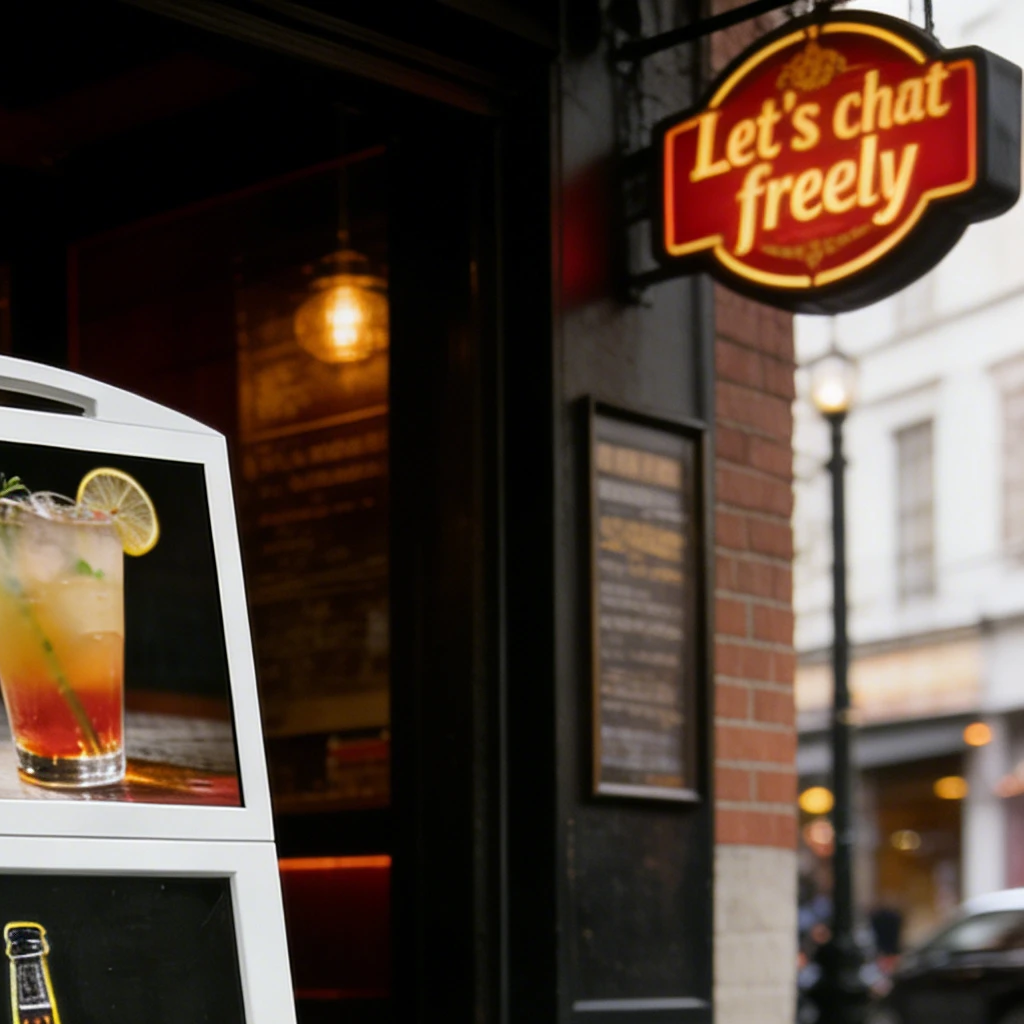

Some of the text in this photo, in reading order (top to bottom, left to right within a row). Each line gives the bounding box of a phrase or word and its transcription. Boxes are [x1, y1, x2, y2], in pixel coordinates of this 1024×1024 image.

[689, 60, 952, 183] Let's chat
[734, 134, 919, 257] freely
